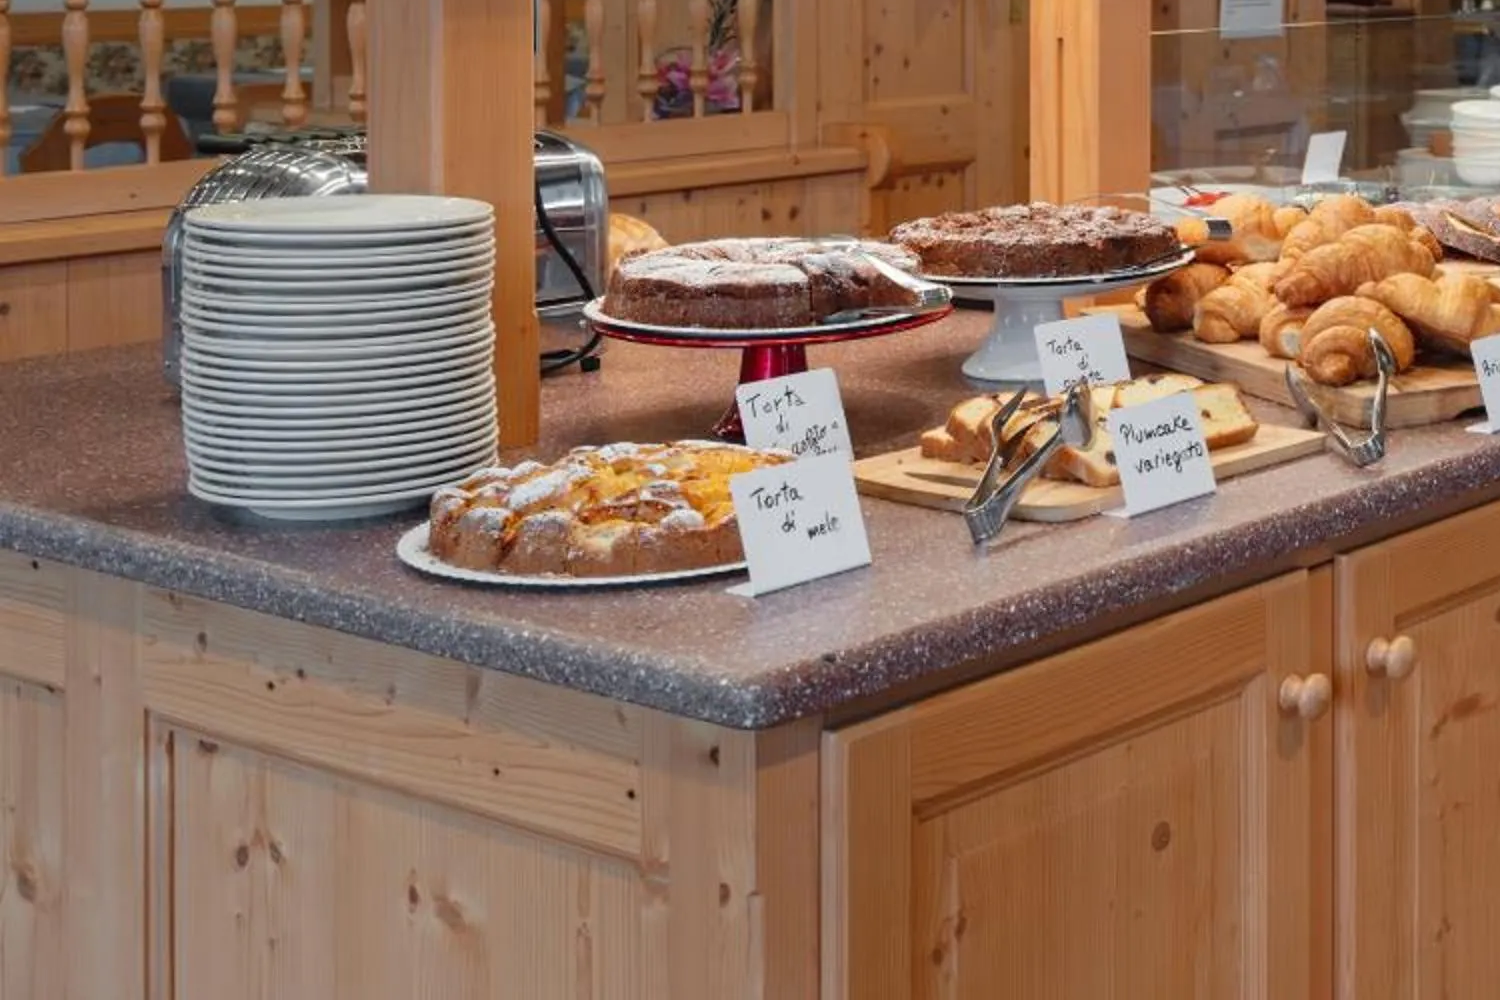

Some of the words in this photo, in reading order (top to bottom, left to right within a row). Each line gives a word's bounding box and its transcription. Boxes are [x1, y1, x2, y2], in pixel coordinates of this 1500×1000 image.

[1046, 335, 1084, 355] Torta
[745, 385, 808, 418] Torta
[776, 413, 790, 434] di
[750, 481, 804, 511] Torta
[781, 510, 797, 533] di
[807, 511, 840, 542] mele
